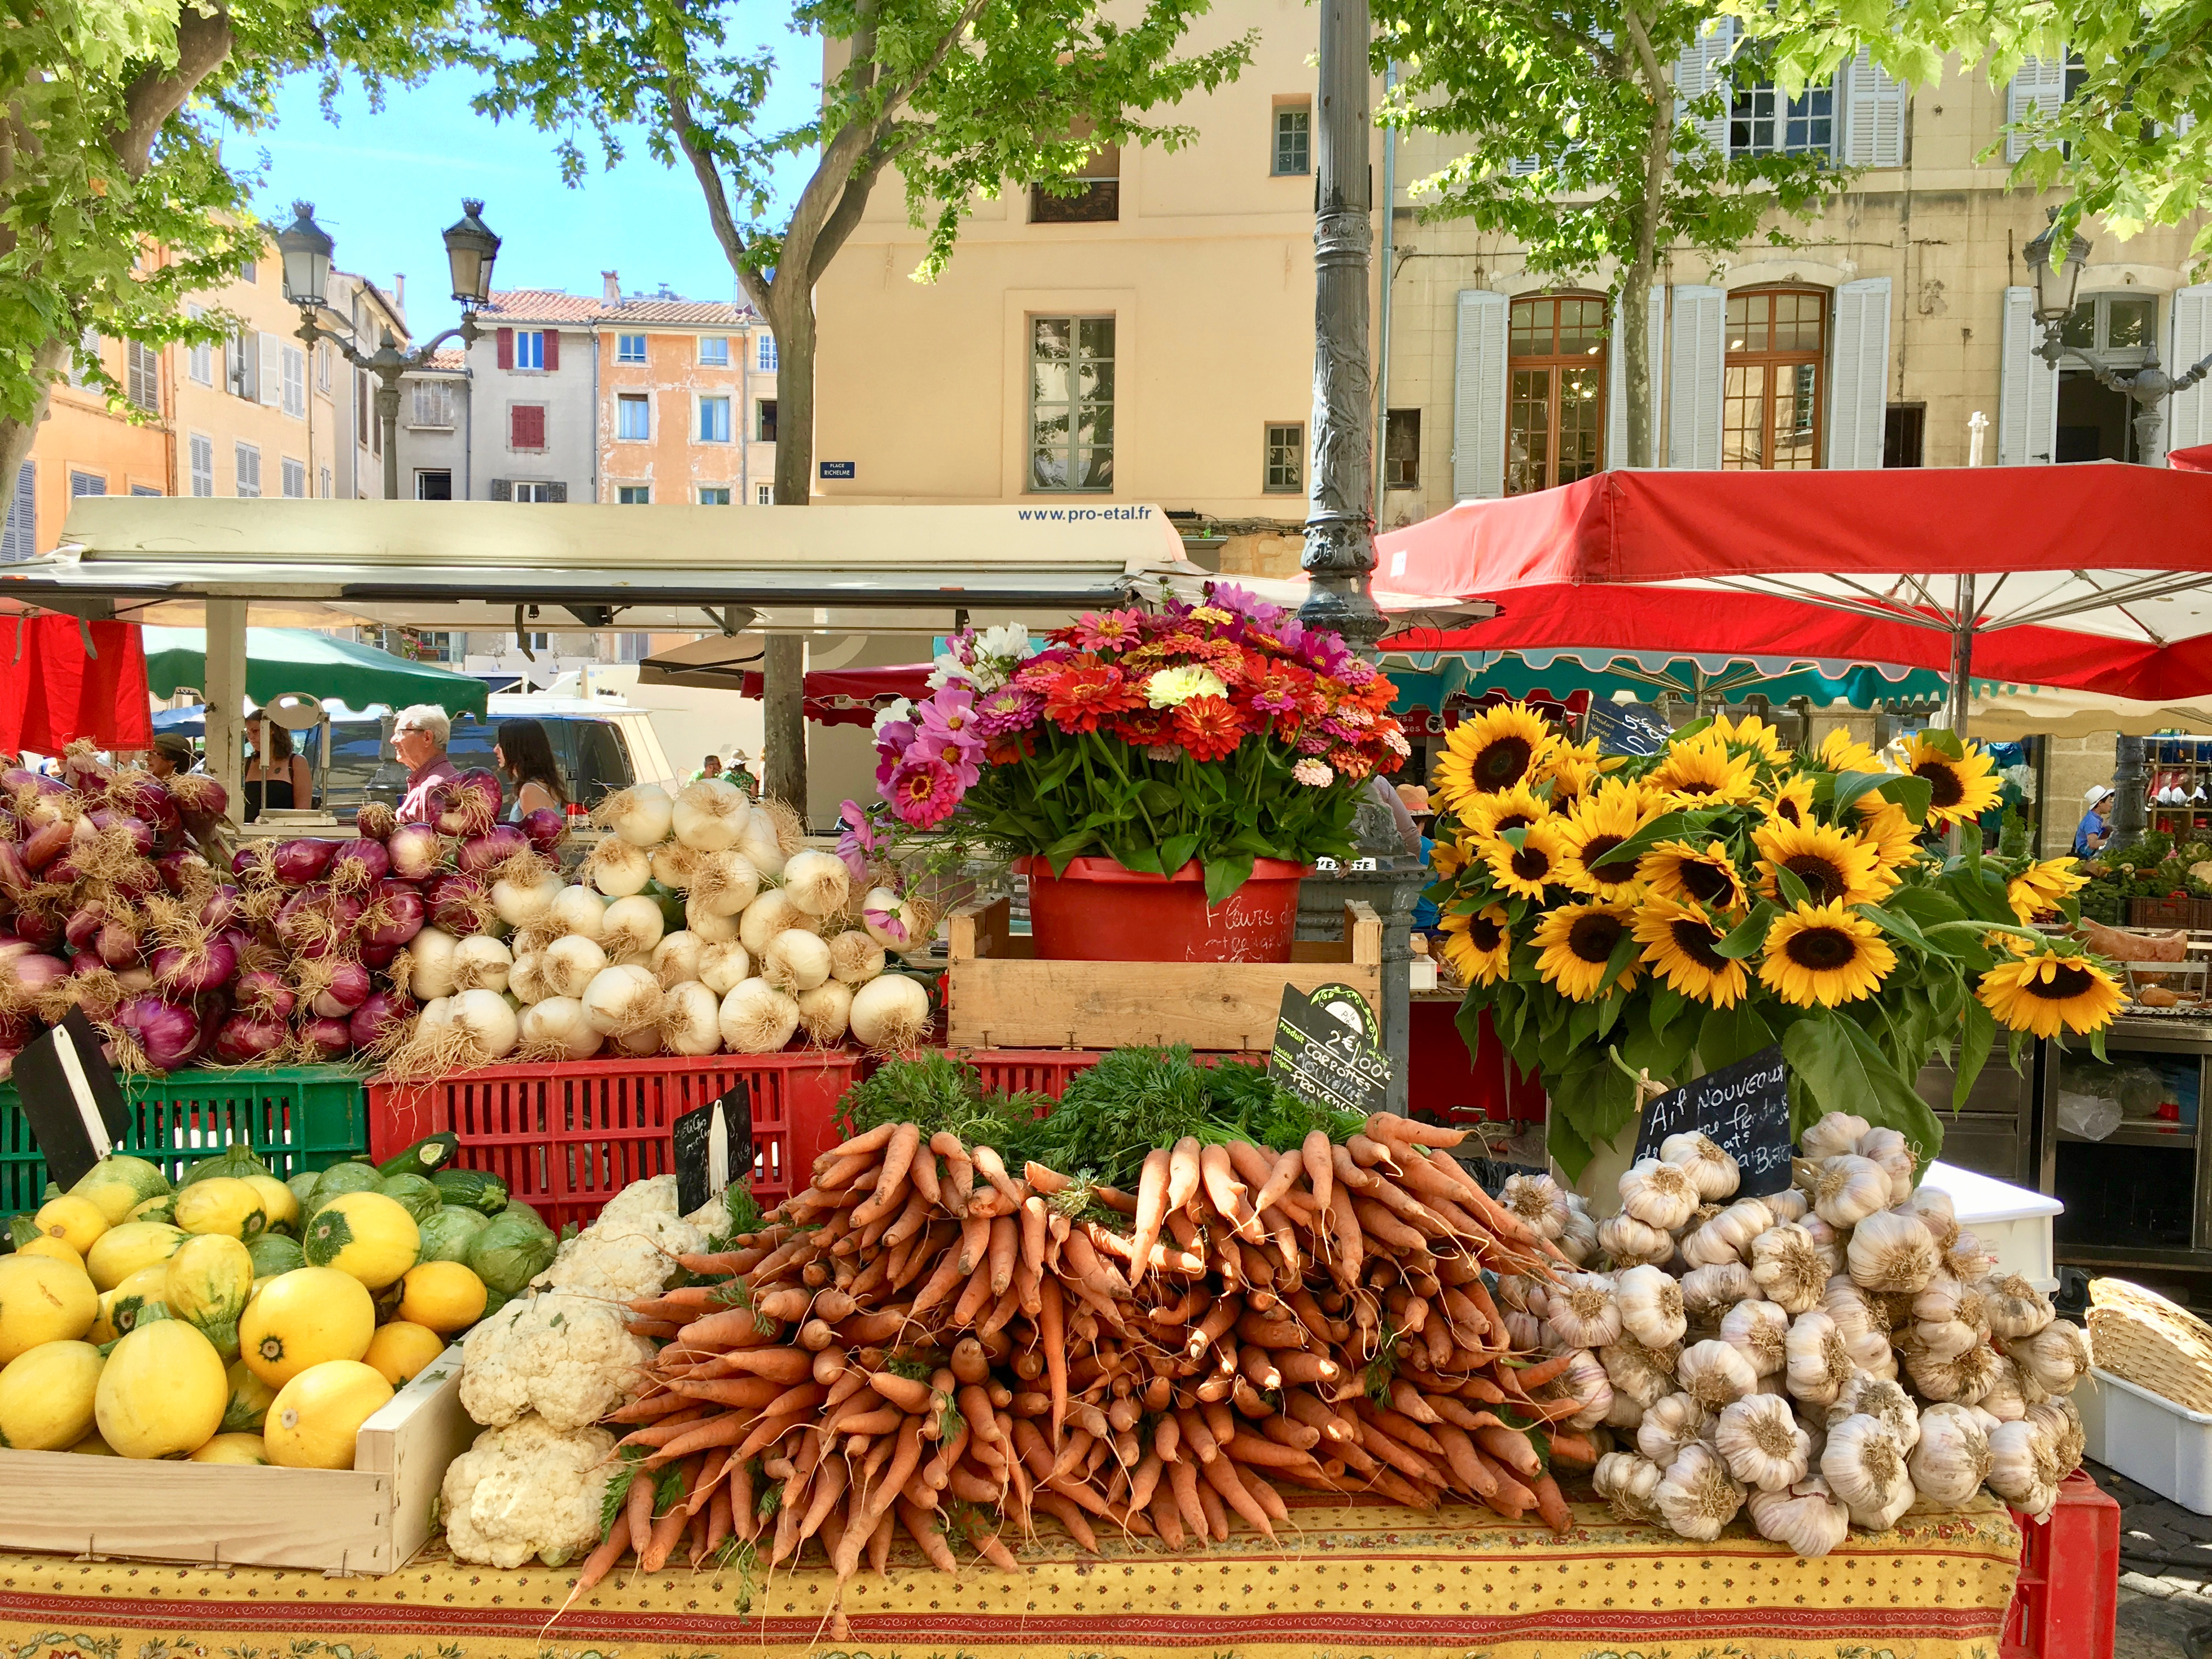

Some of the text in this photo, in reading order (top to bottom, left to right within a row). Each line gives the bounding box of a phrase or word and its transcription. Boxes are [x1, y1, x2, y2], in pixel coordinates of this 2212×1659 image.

[1018, 506, 1152, 523] www.pro-etal.fr
[1592, 714, 1616, 731] Produit
[1279, 1022, 1305, 1044] Produit
[1274, 1043, 1294, 1061] Variété
[1273, 1055, 1292, 1072] Origine
